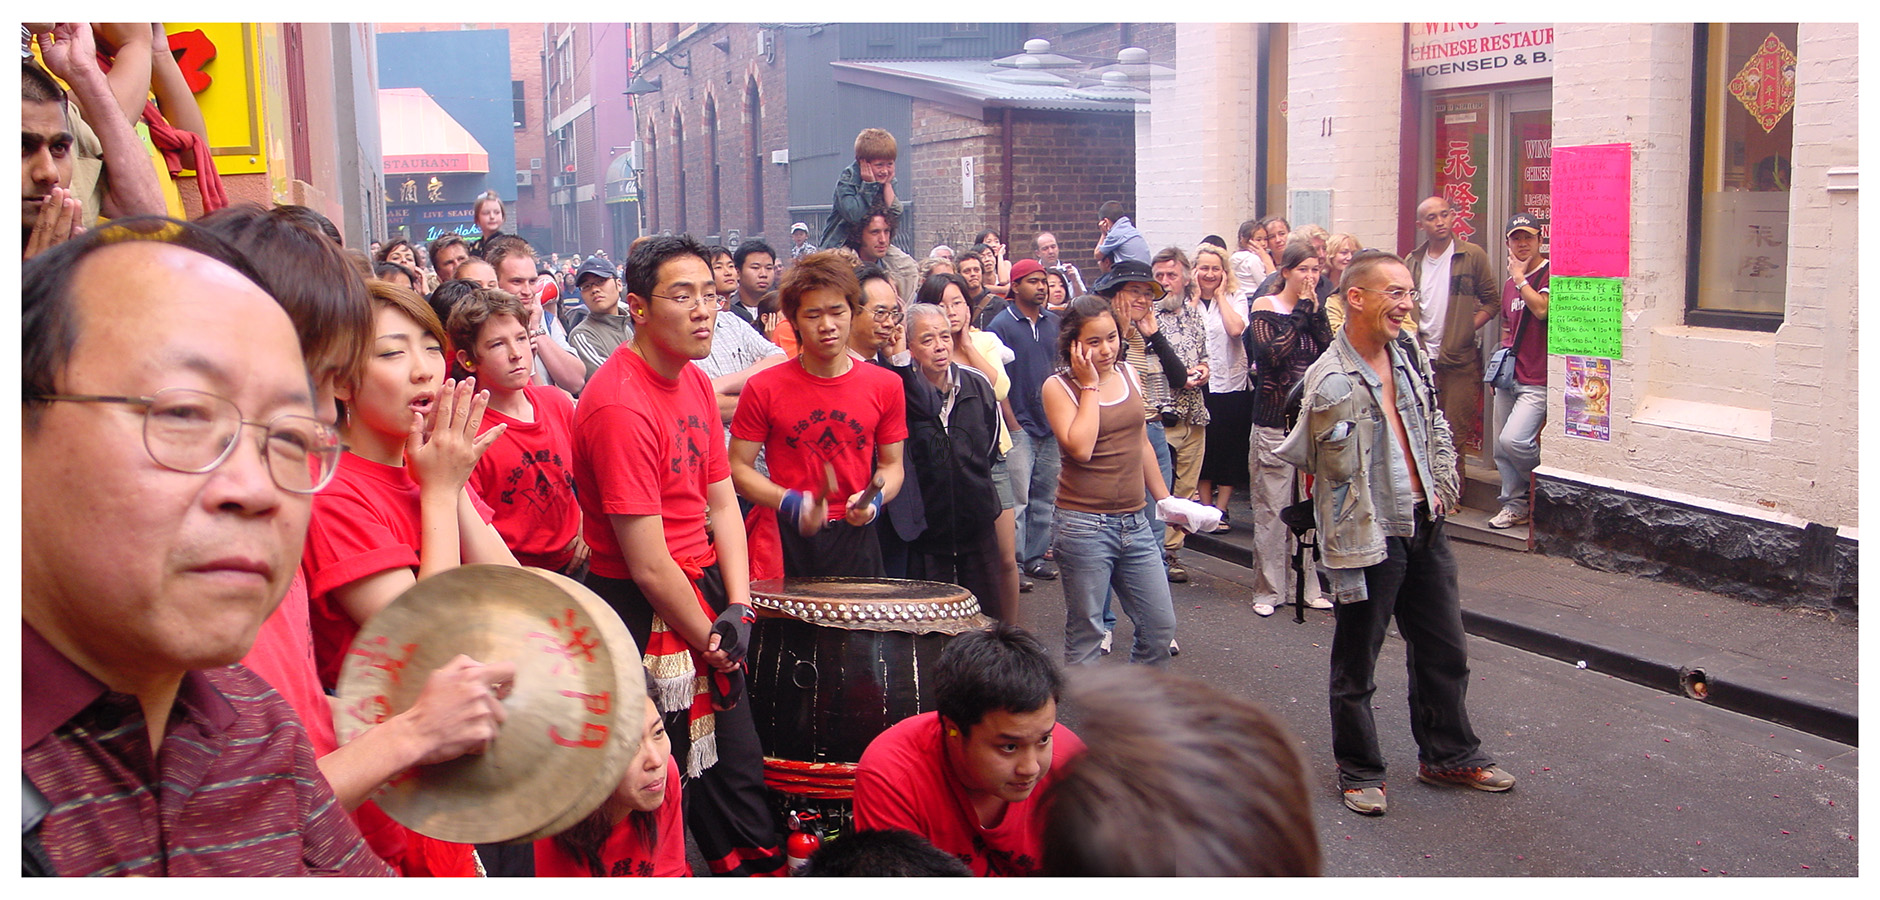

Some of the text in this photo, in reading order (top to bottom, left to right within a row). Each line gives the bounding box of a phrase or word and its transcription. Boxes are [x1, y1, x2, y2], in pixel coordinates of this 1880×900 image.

[1411, 38, 1478, 61] CHINESE
[1411, 56, 1508, 78] LICENSED
[1513, 54, 1527, 66] &
[423, 211, 443, 219] LIVE
